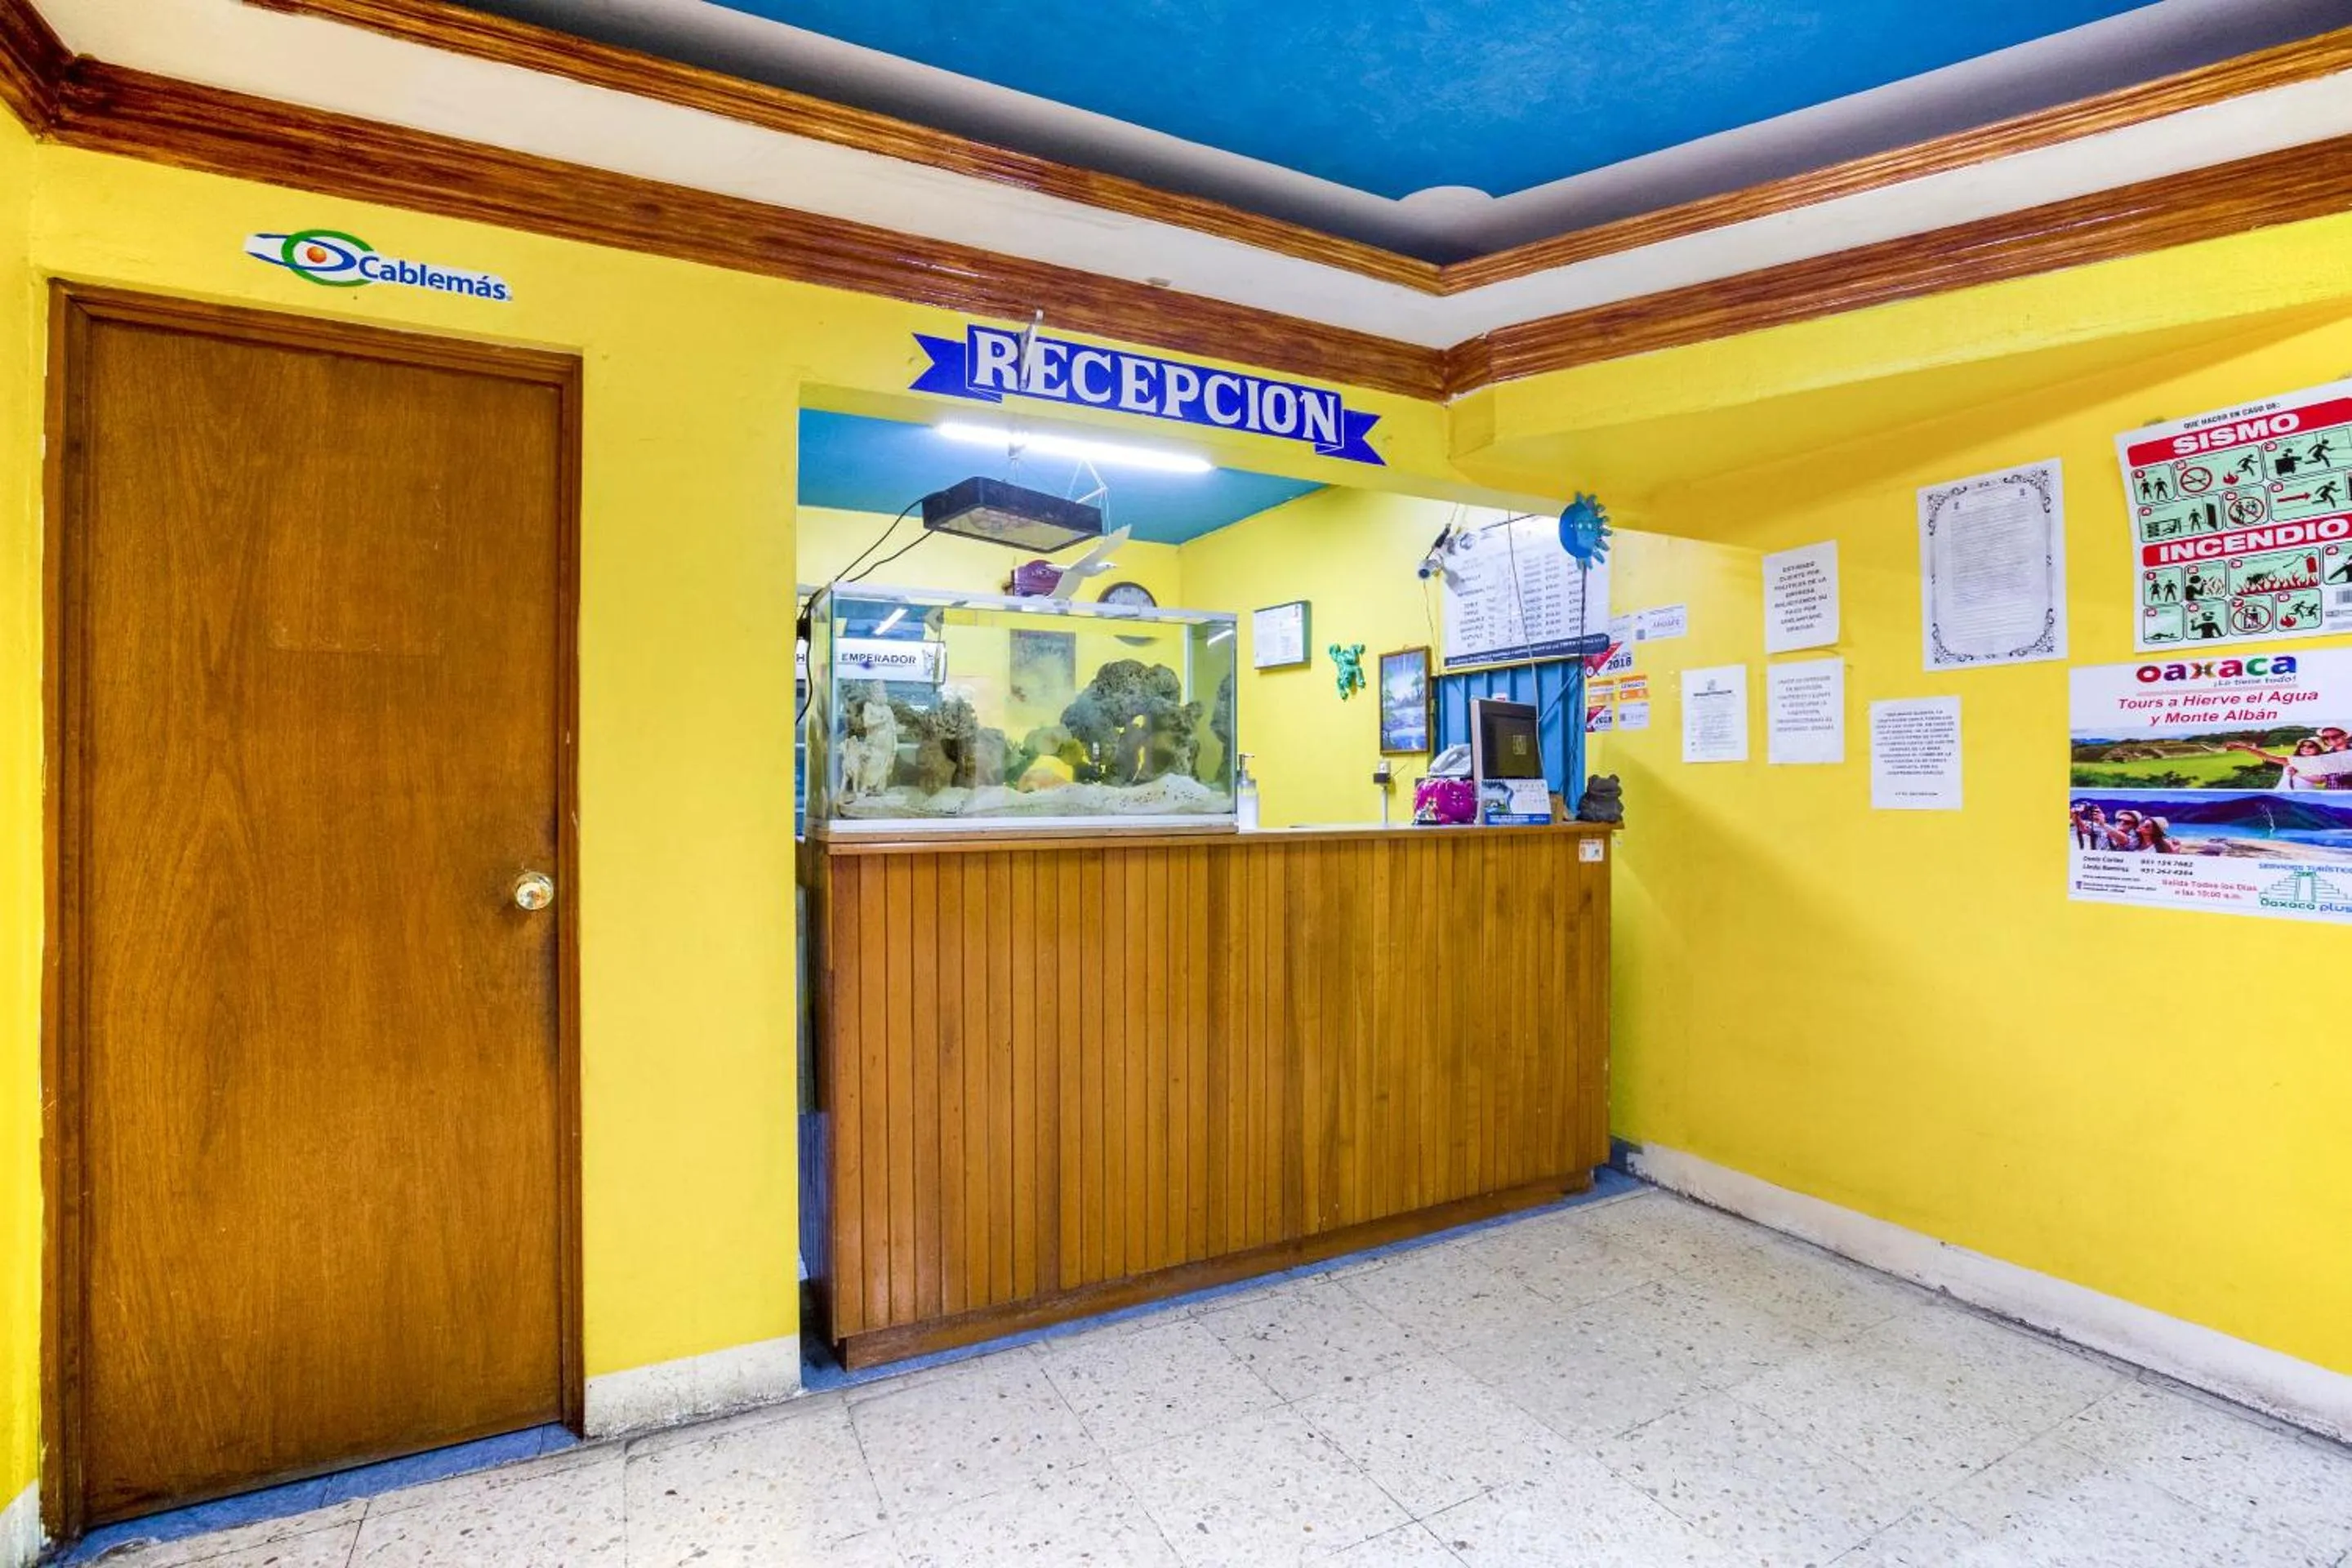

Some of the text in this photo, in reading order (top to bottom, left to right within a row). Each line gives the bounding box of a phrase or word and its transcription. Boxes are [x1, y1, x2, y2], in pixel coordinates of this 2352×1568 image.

[359, 255, 506, 301] Cablemás
[972, 330, 1342, 443] RECEPCION
[2172, 412, 2300, 454] SISMO
[2159, 518, 2348, 563] INCENDIO
[841, 653, 917, 665] EMPERADOR
[2136, 655, 2297, 684] oaxaca
[2118, 690, 2319, 710] Tours a Hierve el Agua
[2149, 708, 2278, 726] y Monte Albán
[2260, 898, 2352, 913] Oaxaca plus
